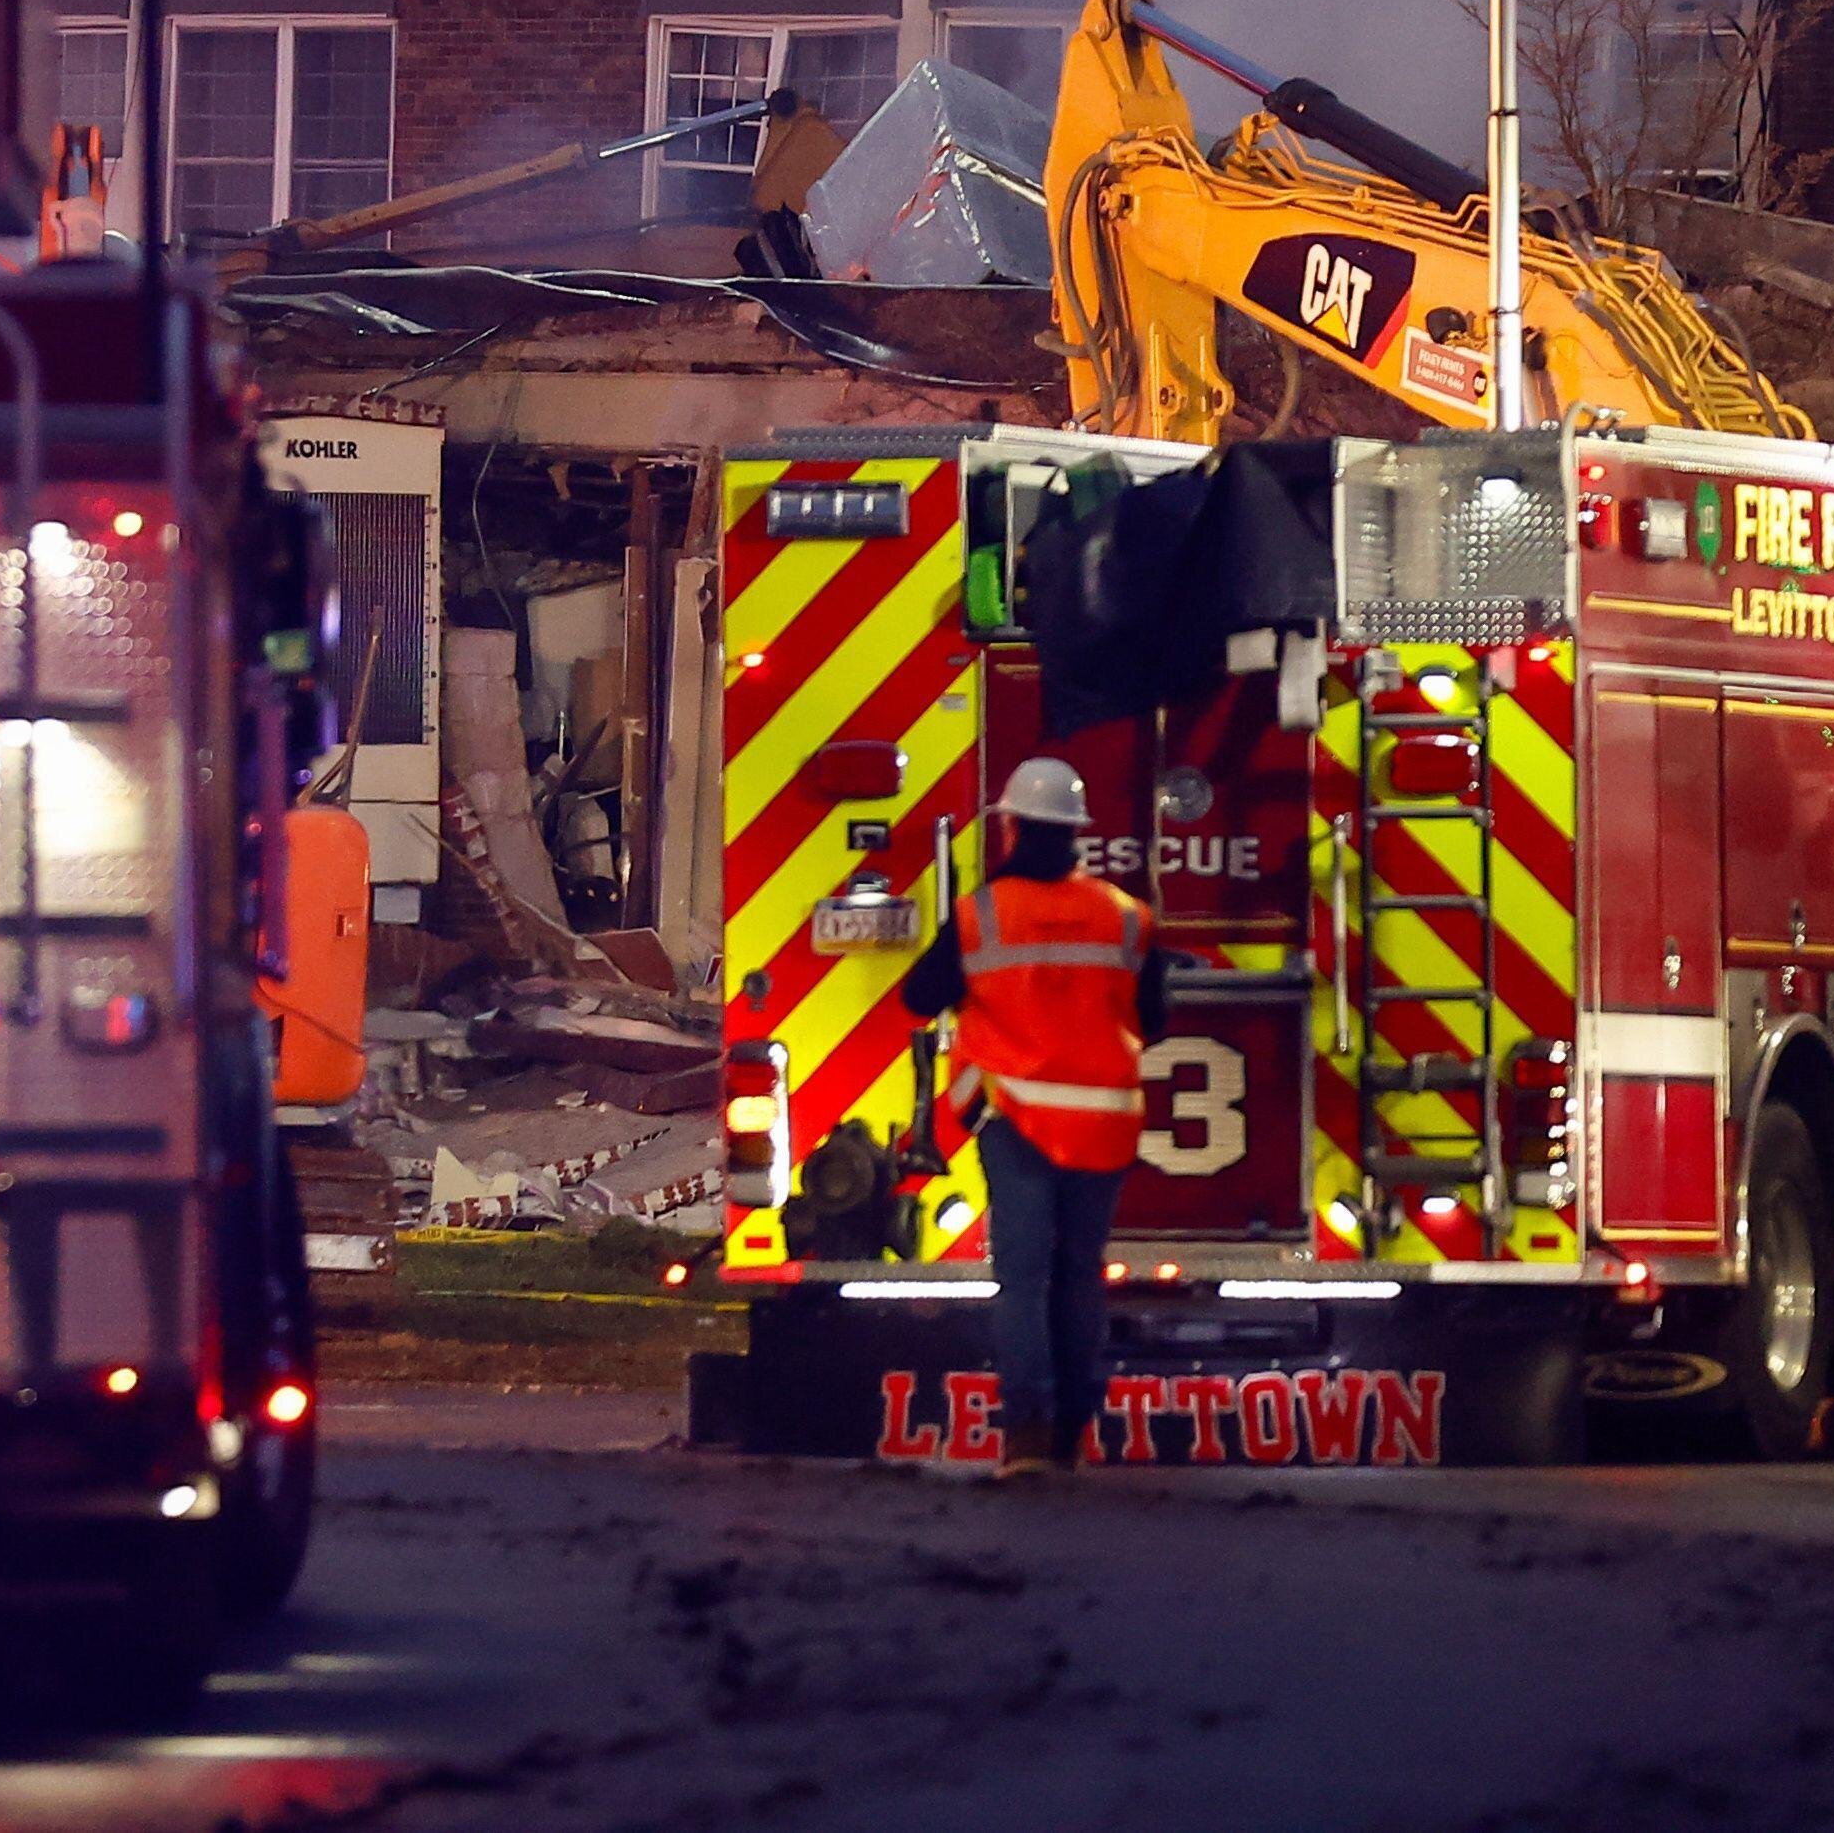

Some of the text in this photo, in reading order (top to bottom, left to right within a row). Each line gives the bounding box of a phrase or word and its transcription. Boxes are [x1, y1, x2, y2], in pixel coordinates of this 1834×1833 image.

[1300, 243, 1373, 349] CAT
[285, 439, 359, 459] KOHLER
[1733, 483, 1815, 568] FIRE
[1073, 835, 1261, 880] ESCUE
[876, 1370, 1446, 1467] LETTOWN
